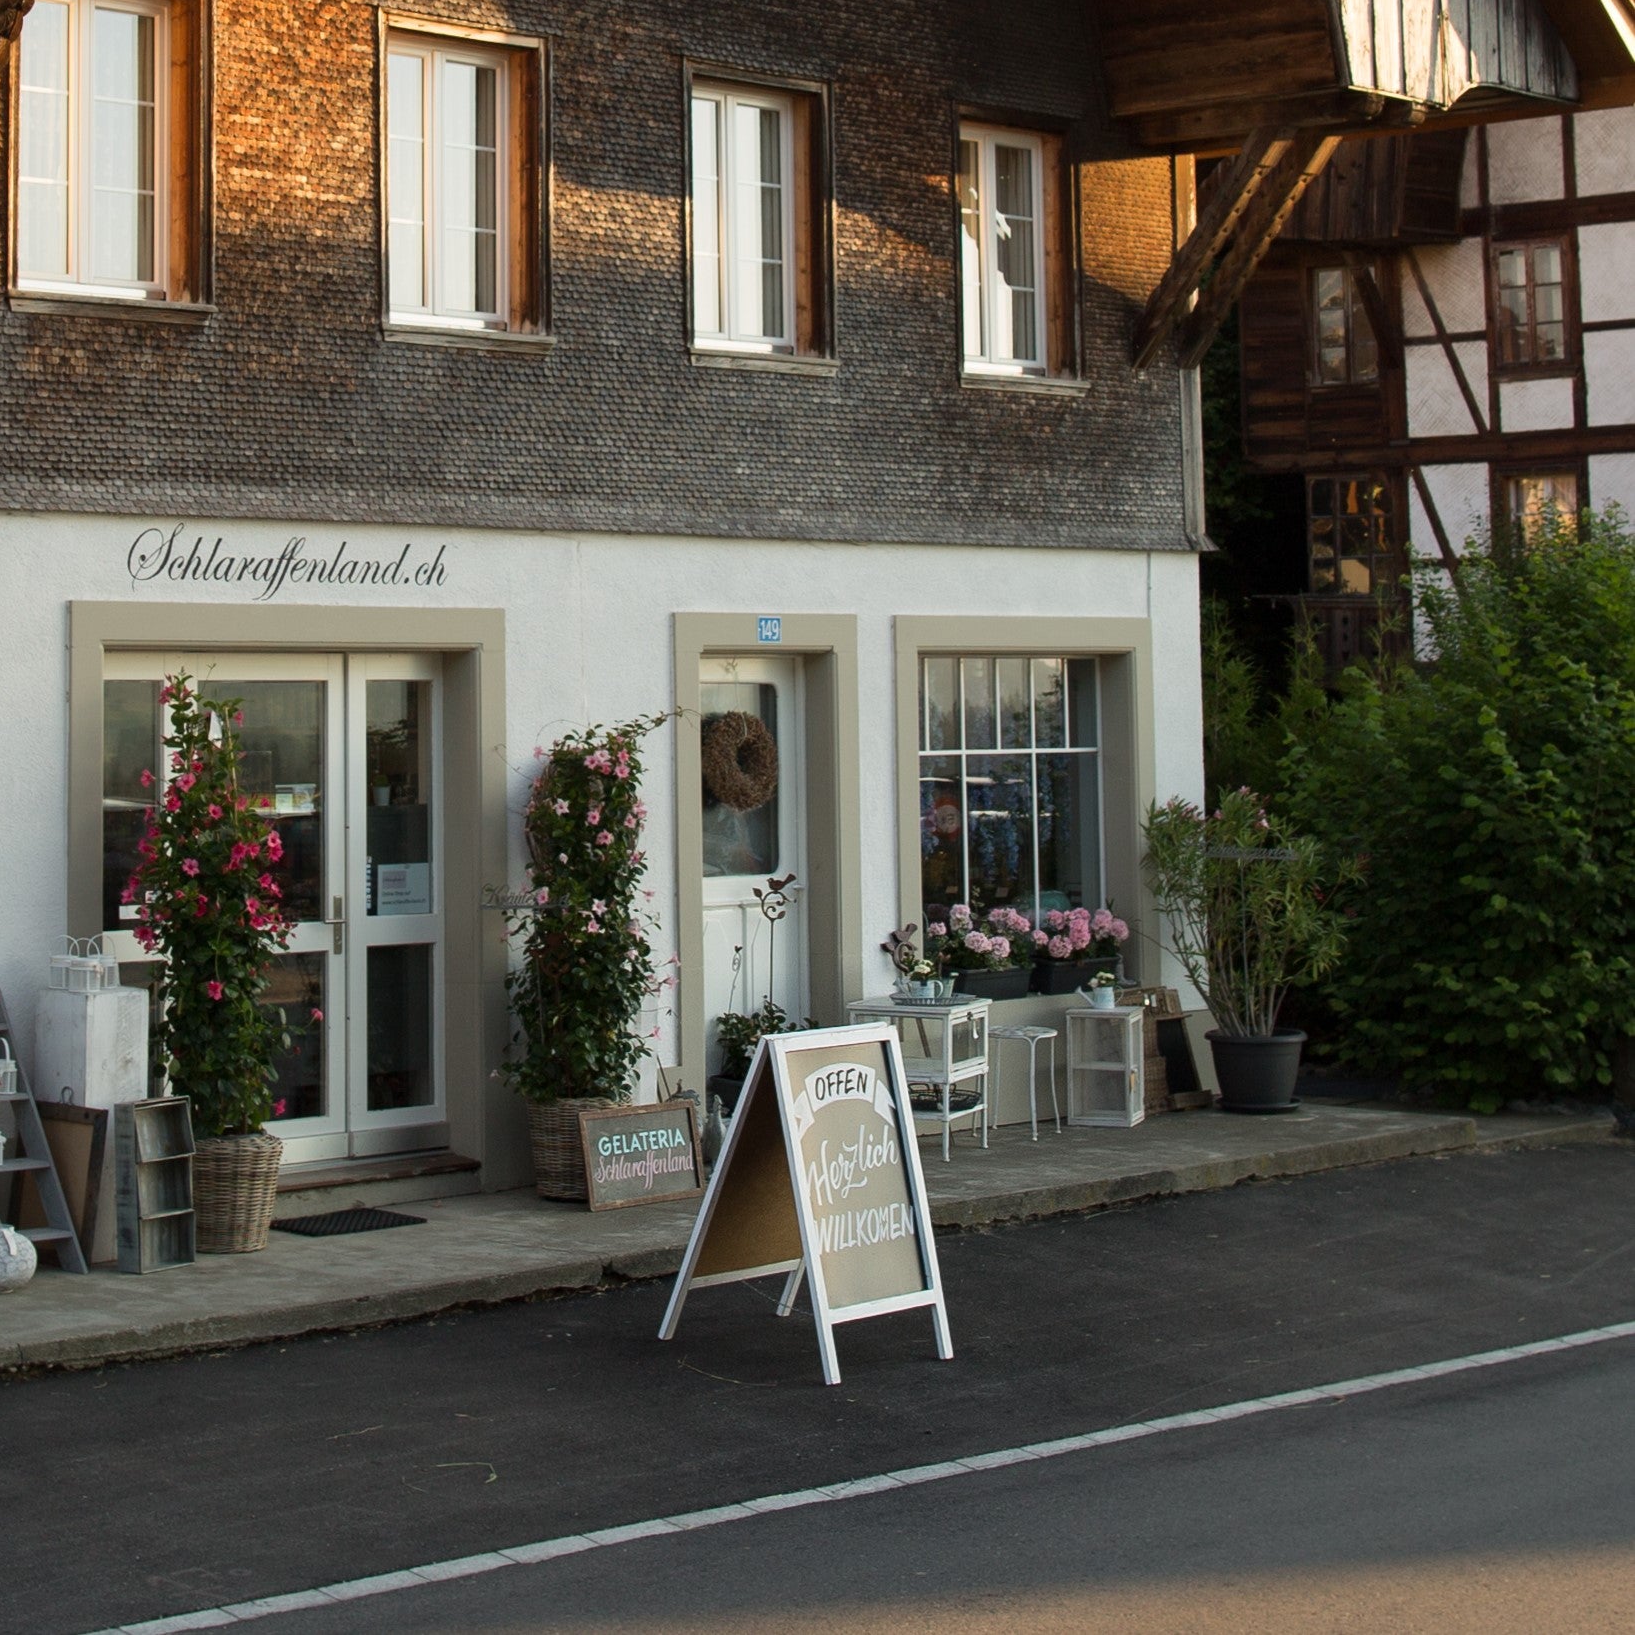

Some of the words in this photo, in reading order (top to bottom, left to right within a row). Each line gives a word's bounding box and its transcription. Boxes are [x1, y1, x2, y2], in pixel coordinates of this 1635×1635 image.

[127, 523, 448, 601] Schlaraffenland.ch
[760, 620, 779, 640] 149
[815, 1068, 868, 1101] OFFEN
[598, 1128, 685, 1156] GELATERIA
[594, 1141, 694, 1190] Schlaraffenland
[807, 1124, 899, 1207] Herzlich
